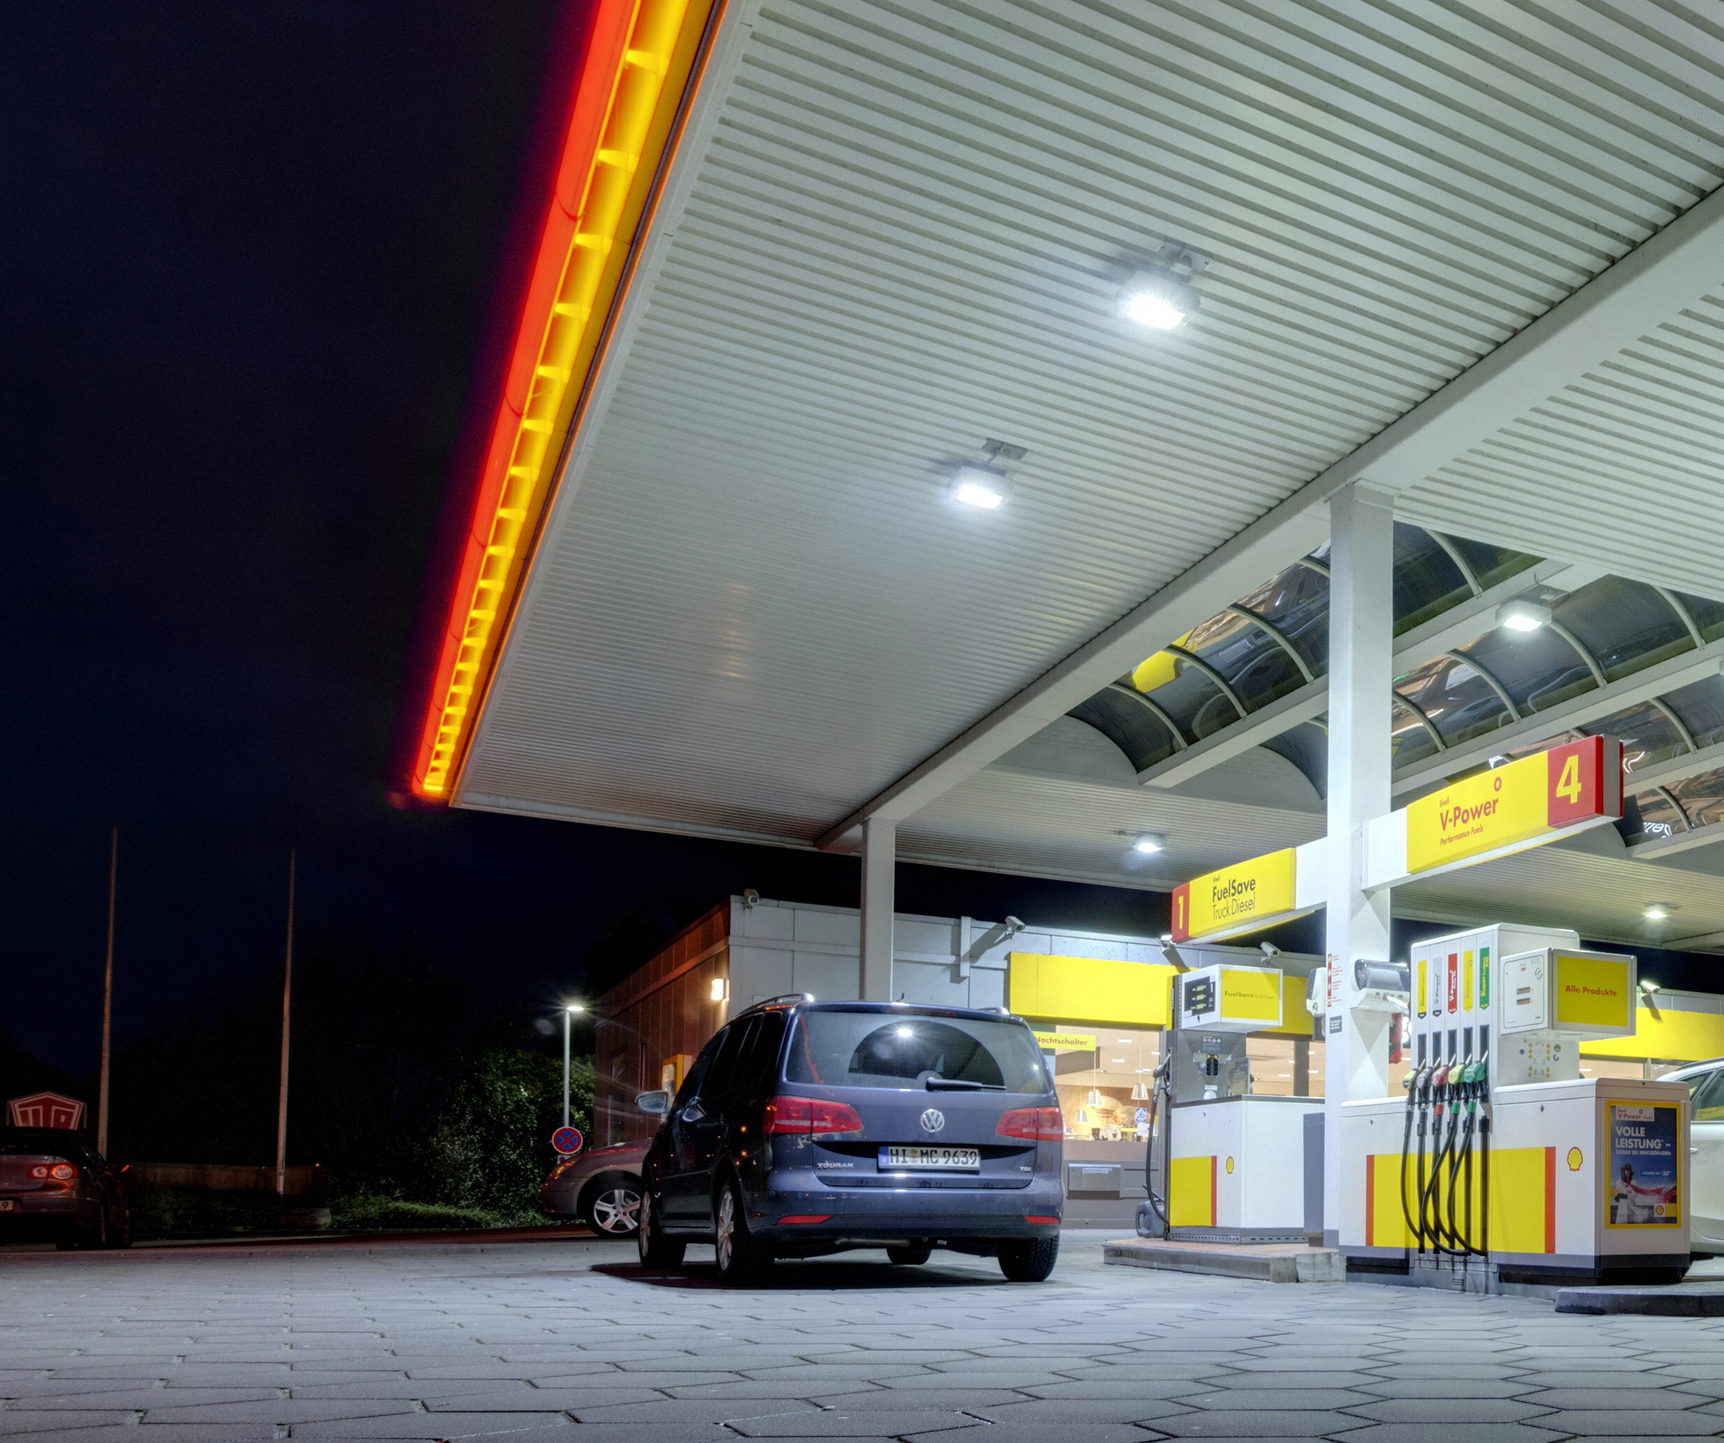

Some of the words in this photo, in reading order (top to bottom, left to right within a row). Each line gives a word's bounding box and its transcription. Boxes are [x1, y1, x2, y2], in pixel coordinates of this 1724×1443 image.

[1556, 754, 1582, 804] 4
[1439, 797, 1449, 807] Shell
[1440, 798, 1499, 831] V-Power
[1440, 830, 1470, 846] Performance
[1471, 825, 1484, 837] Fuels
[1212, 878, 1256, 903] FuelSave
[1178, 895, 1184, 930] 1
[1212, 907, 1230, 921] Truck
[1231, 901, 1256, 916] Diesel
[1224, 990, 1254, 999] FuelSave
[1565, 985, 1580, 994] Alle
[1582, 986, 1617, 997] Produkte
[1035, 1036, 1088, 1047] Nachtschalter
[1616, 1126, 1645, 1137] VOLLE
[890, 1148, 908, 1164] HI
[920, 1150, 938, 1164] MC
[943, 1150, 978, 1165] 9639
